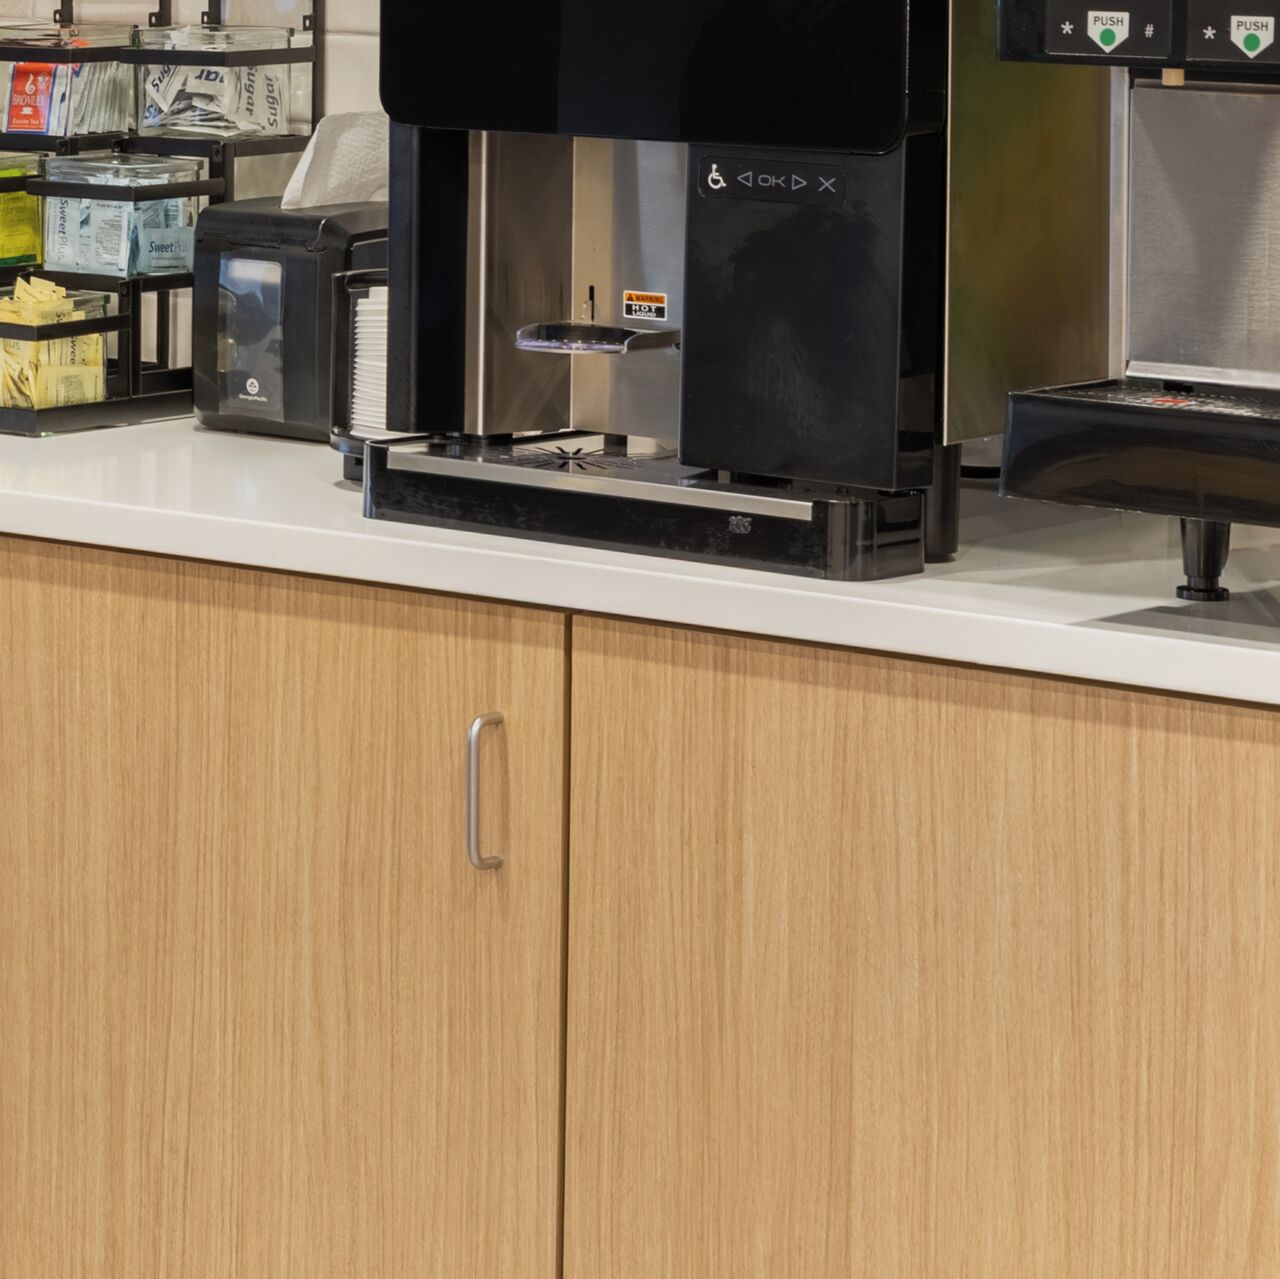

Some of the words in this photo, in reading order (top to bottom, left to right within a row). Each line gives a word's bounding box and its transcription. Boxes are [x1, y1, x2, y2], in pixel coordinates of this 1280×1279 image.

[1093, 16, 1124, 26] PUSH
[1236, 21, 1269, 31] PUSH
[264, 74, 279, 129] Sugar
[758, 174, 786, 188] OK
[149, 241, 189, 253] SweetPlus
[632, 304, 656, 312] HOT
